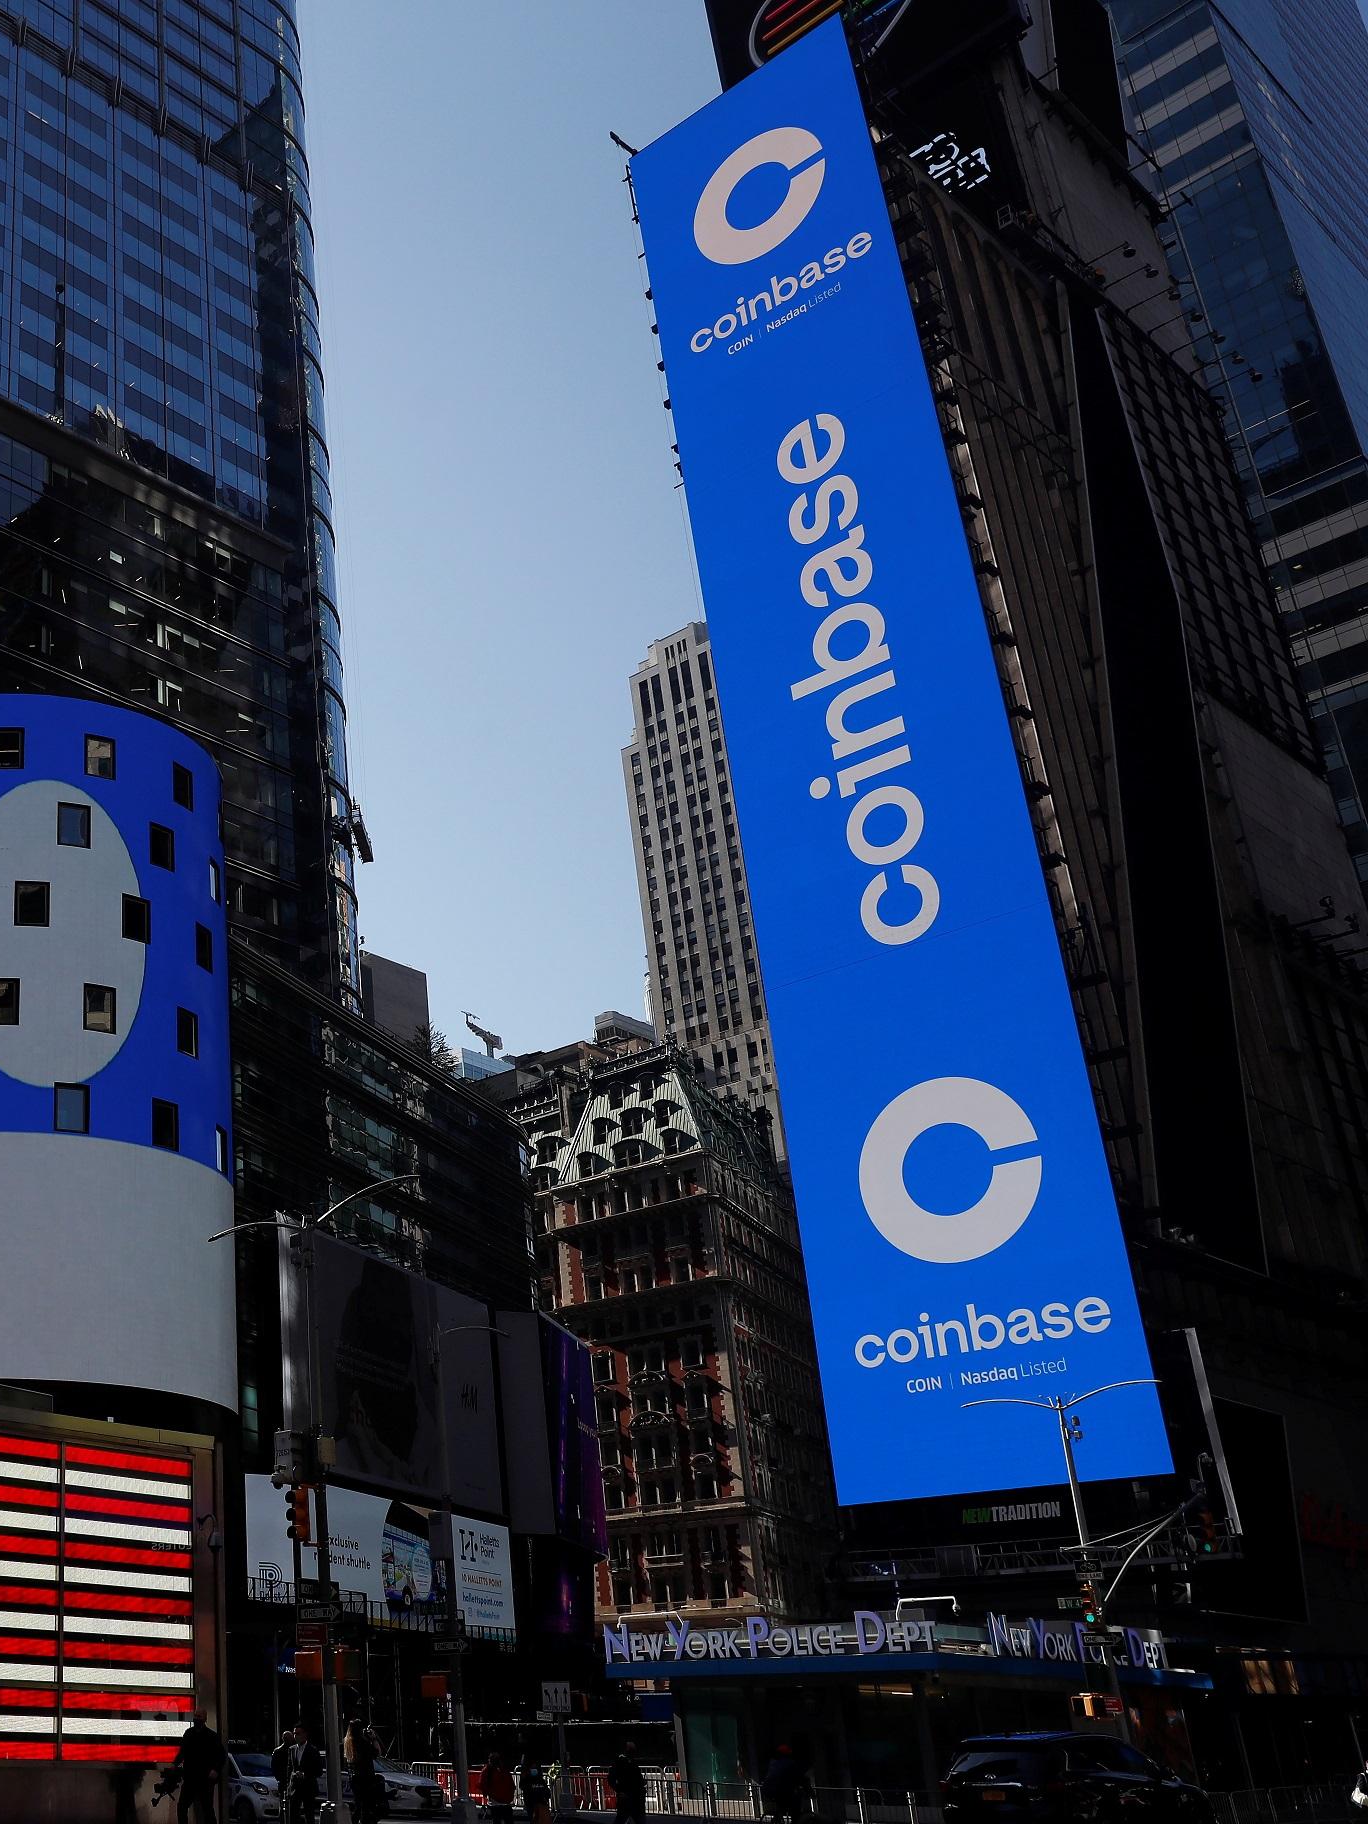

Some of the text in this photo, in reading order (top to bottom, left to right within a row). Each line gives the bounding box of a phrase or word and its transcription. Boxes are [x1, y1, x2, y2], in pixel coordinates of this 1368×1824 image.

[689, 230, 873, 354] coinbase
[727, 281, 842, 356] COIN Nasdaq Listed
[776, 412, 940, 946] coinbase
[854, 1296, 1112, 1369] coinbase
[906, 1357, 1067, 1395] COIN Nasdaq Listed
[313, 1550, 371, 1570] rdent shuttle
[328, 1534, 359, 1551] xclusive
[480, 1545, 495, 1559] Point
[304, 1605, 336, 1618] ONE WAY
[602, 1610, 936, 1664] NEW YORK POLICE DEPT
